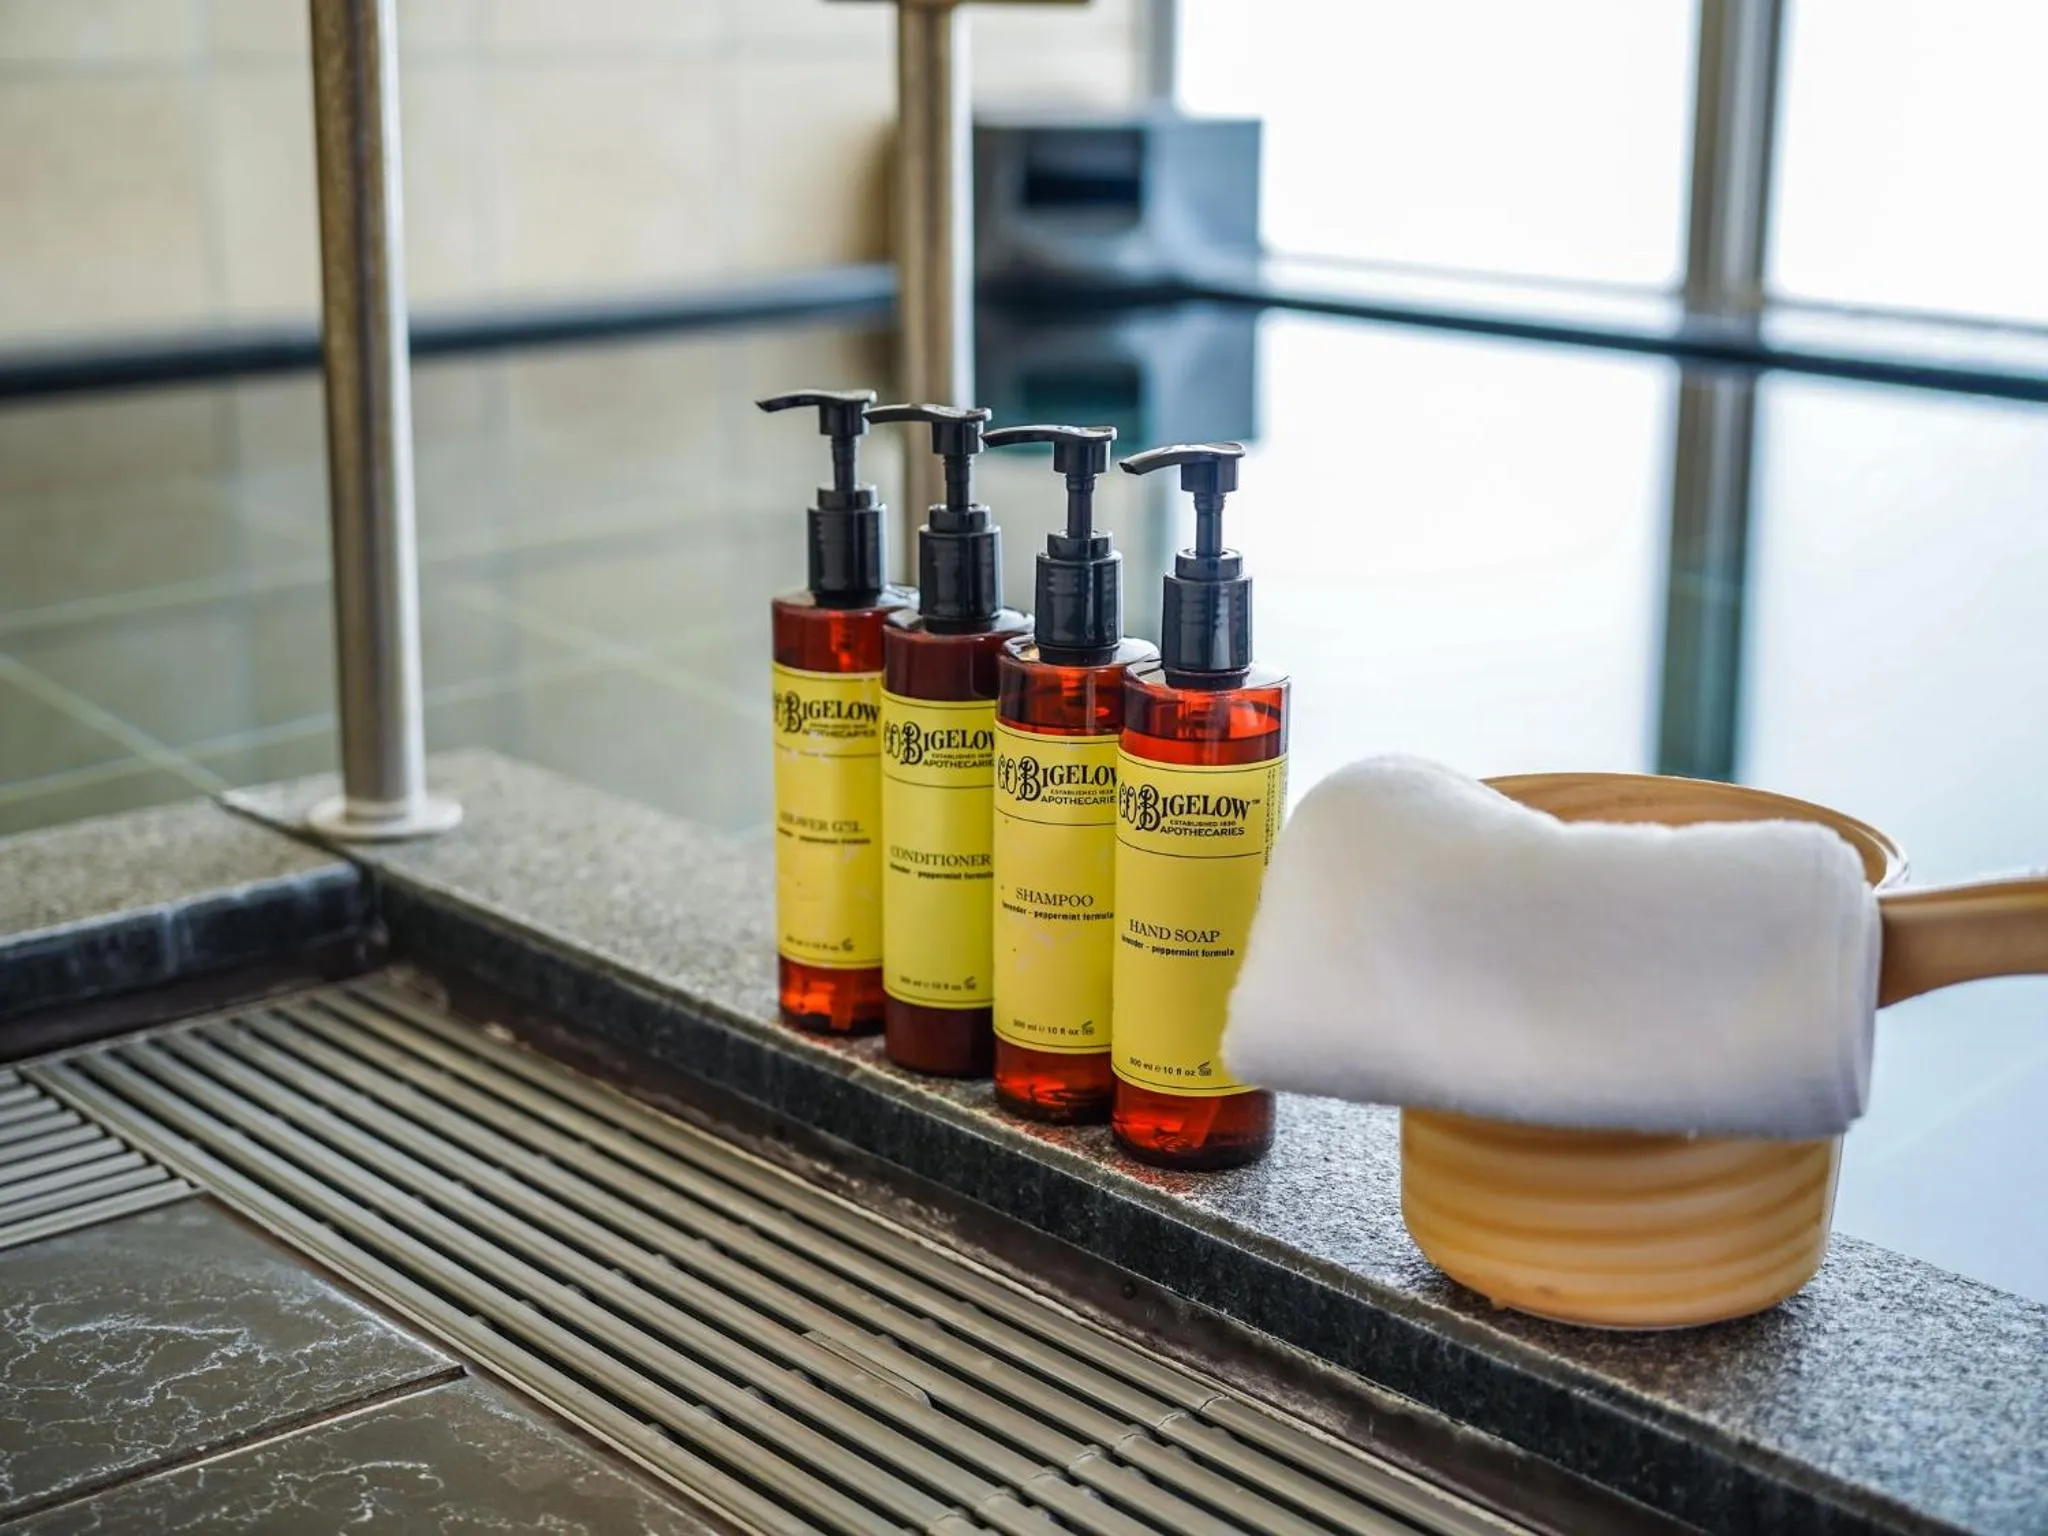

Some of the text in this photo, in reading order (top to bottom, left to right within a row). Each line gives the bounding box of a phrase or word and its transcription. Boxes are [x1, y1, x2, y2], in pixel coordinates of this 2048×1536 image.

[783, 690, 881, 733] BIGELOW
[900, 720, 994, 765] BIGELO
[922, 759, 994, 769] APOTHECARIE
[1015, 756, 1117, 801] BIGELO
[1040, 795, 1117, 806] APOTHECARIE
[1135, 784, 1251, 831] BIGELOW
[1159, 825, 1246, 837] APOTHECARIES
[1169, 819, 1218, 828] ESTABLISHED
[889, 846, 991, 867] CONDITIONER
[1015, 887, 1095, 908] SHAMPOO
[1033, 909, 1081, 921] peppermint
[1082, 910, 1115, 921] formula
[1129, 918, 1221, 944] HAND SOAP
[1151, 945, 1200, 957] peppermint
[1201, 947, 1236, 957] formula
[1163, 1066, 1174, 1075] 10
